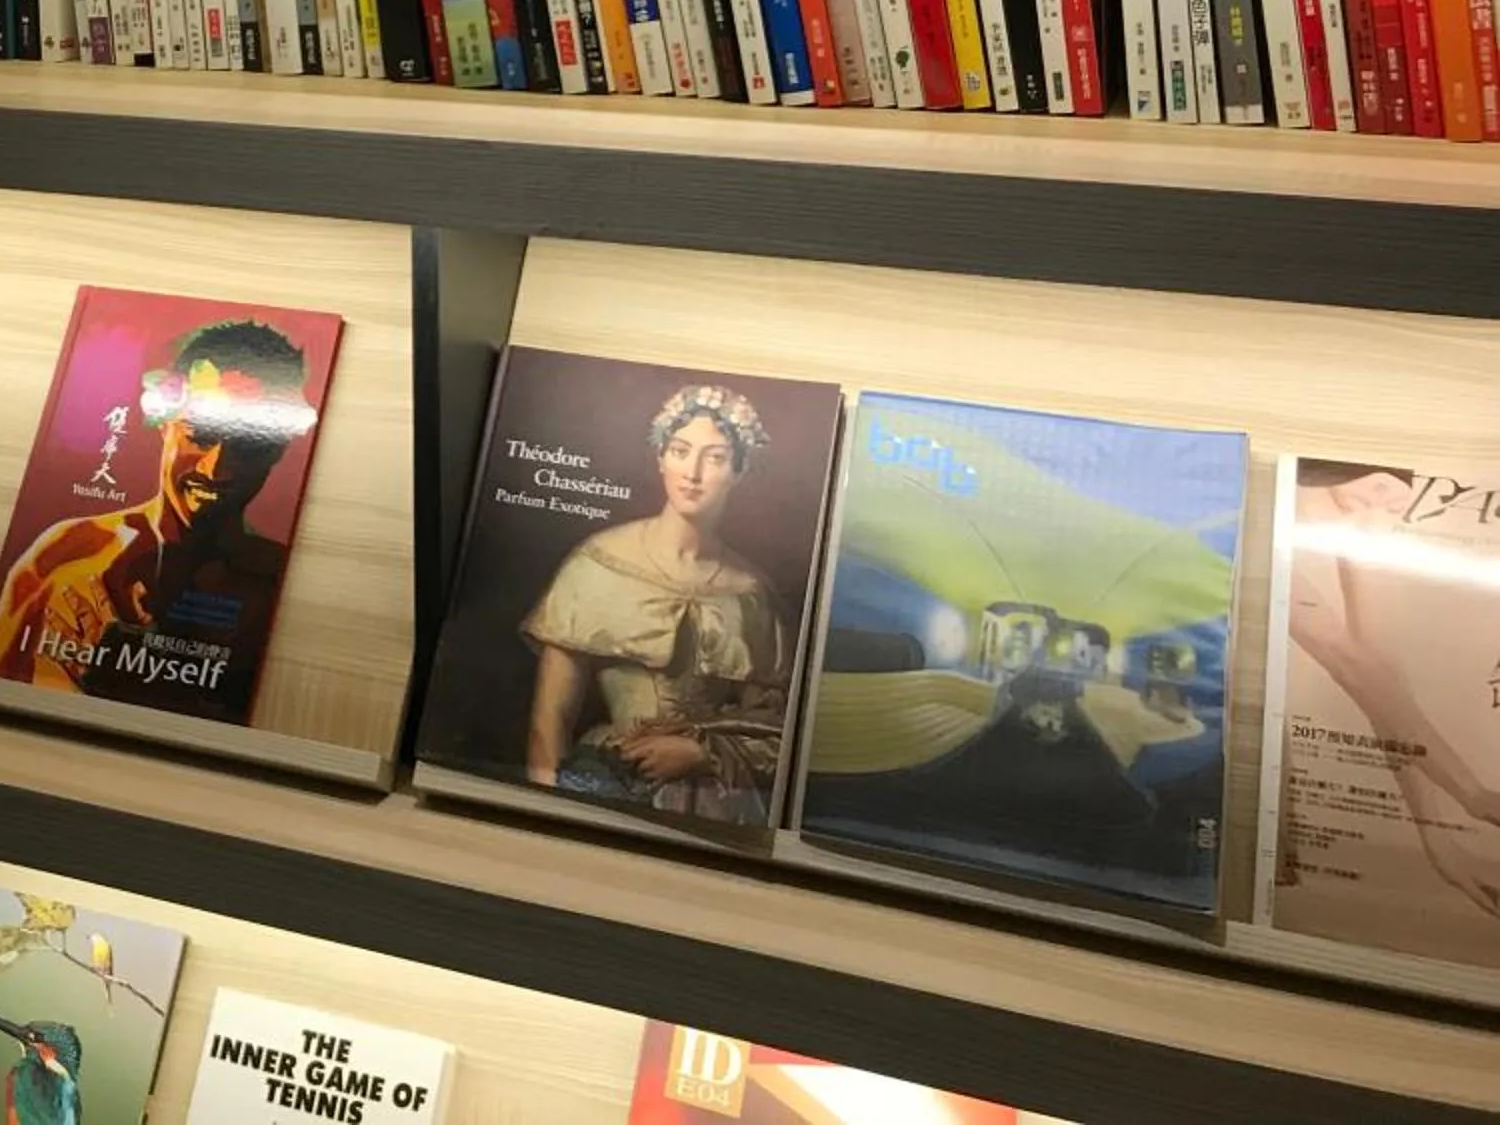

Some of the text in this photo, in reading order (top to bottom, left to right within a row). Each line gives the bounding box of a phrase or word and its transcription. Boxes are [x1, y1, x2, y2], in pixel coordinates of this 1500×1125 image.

[504, 438, 591, 469] Théodore
[106, 488, 128, 503] Art
[532, 468, 632, 500] Chassériau
[494, 487, 612, 521] Parfum Exotique
[19, 624, 229, 690] I Hear Myself
[301, 1029, 352, 1064] THE
[672, 1027, 742, 1086] ID
[209, 1034, 430, 1113] INNER GAME OF
[265, 1077, 364, 1125] TENNIS
